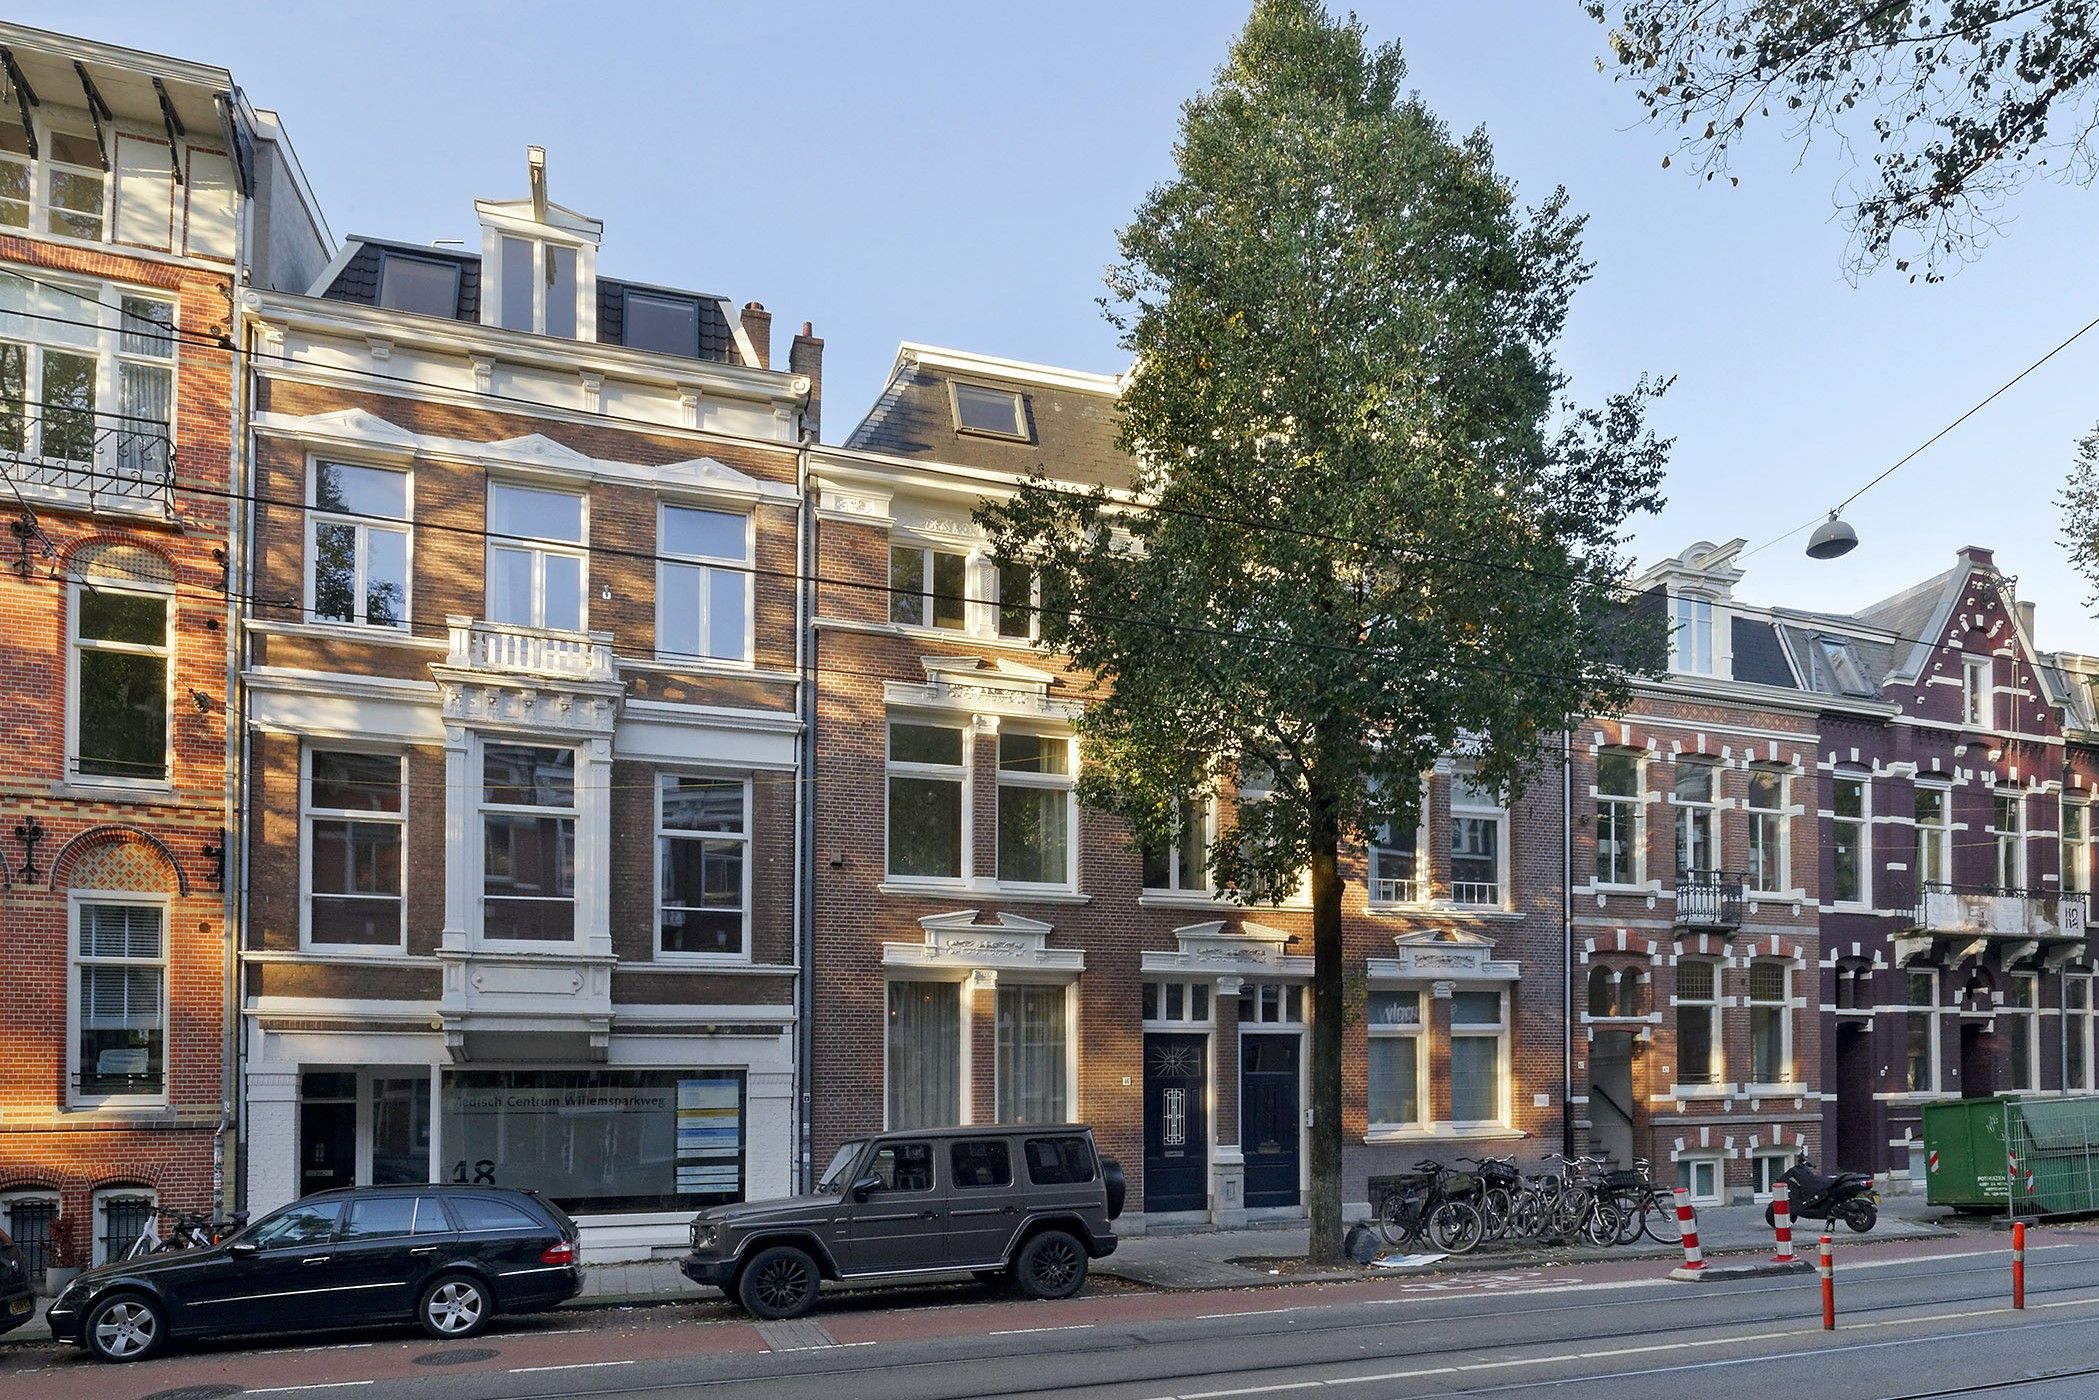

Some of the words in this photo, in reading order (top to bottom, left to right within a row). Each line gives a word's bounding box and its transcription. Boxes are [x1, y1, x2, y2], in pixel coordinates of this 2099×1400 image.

[507, 1097, 560, 1107] Centrum
[564, 1096, 666, 1108] Willemsparkweg
[453, 1159, 496, 1185] 18
